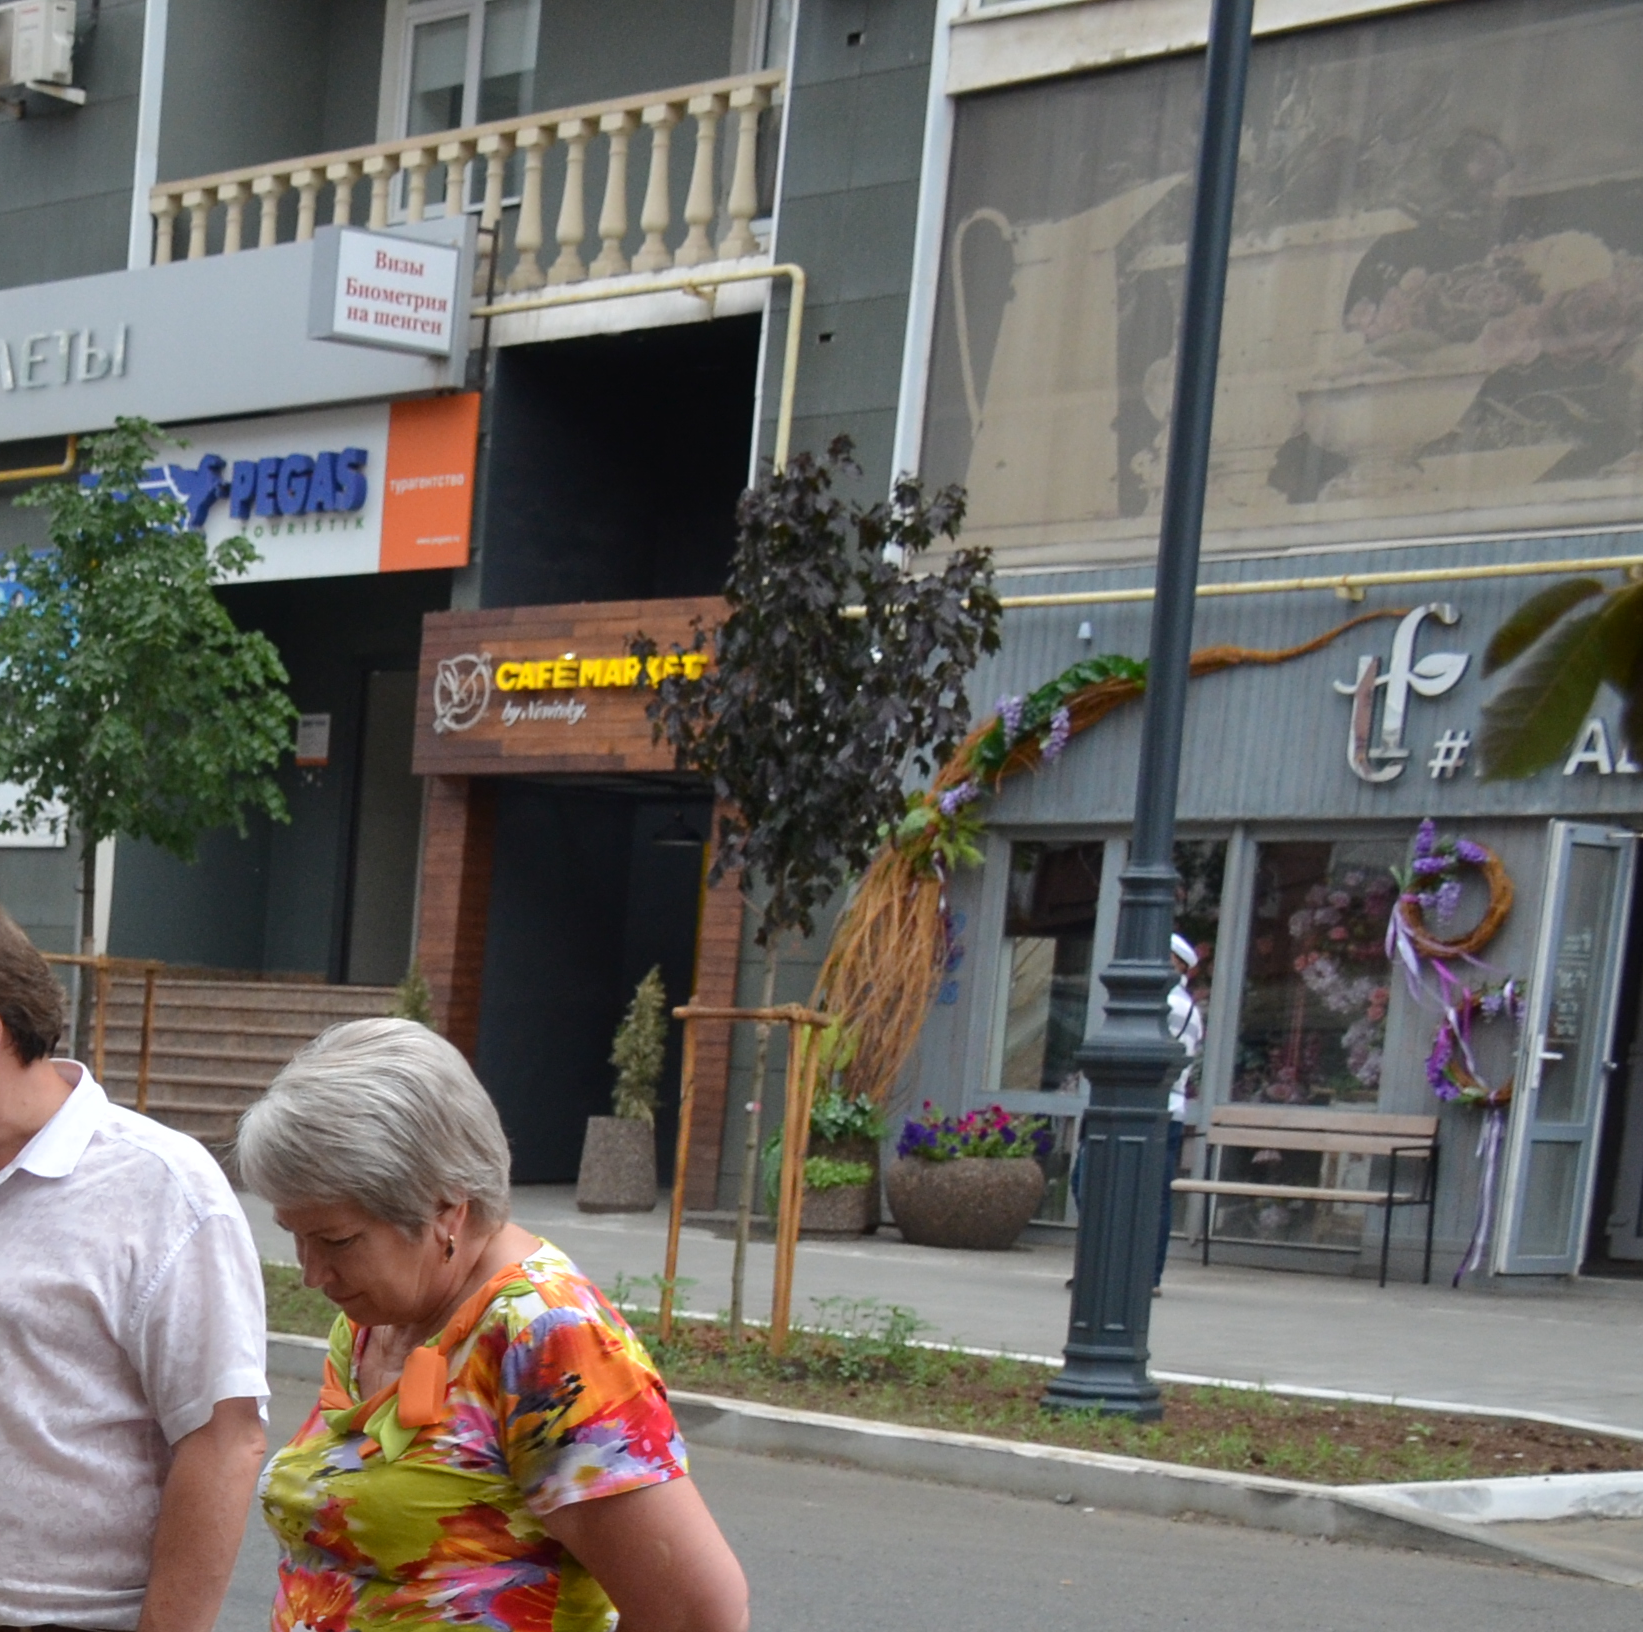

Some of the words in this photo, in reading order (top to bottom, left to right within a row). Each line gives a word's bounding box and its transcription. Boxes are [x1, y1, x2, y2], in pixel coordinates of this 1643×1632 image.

[374, 250, 424, 277] Визы
[345, 277, 448, 313] Биометрия
[347, 304, 369, 323] на
[373, 311, 442, 336] шенген
[229, 447, 369, 521] PEGAS
[239, 516, 364, 538] TOURISTIK
